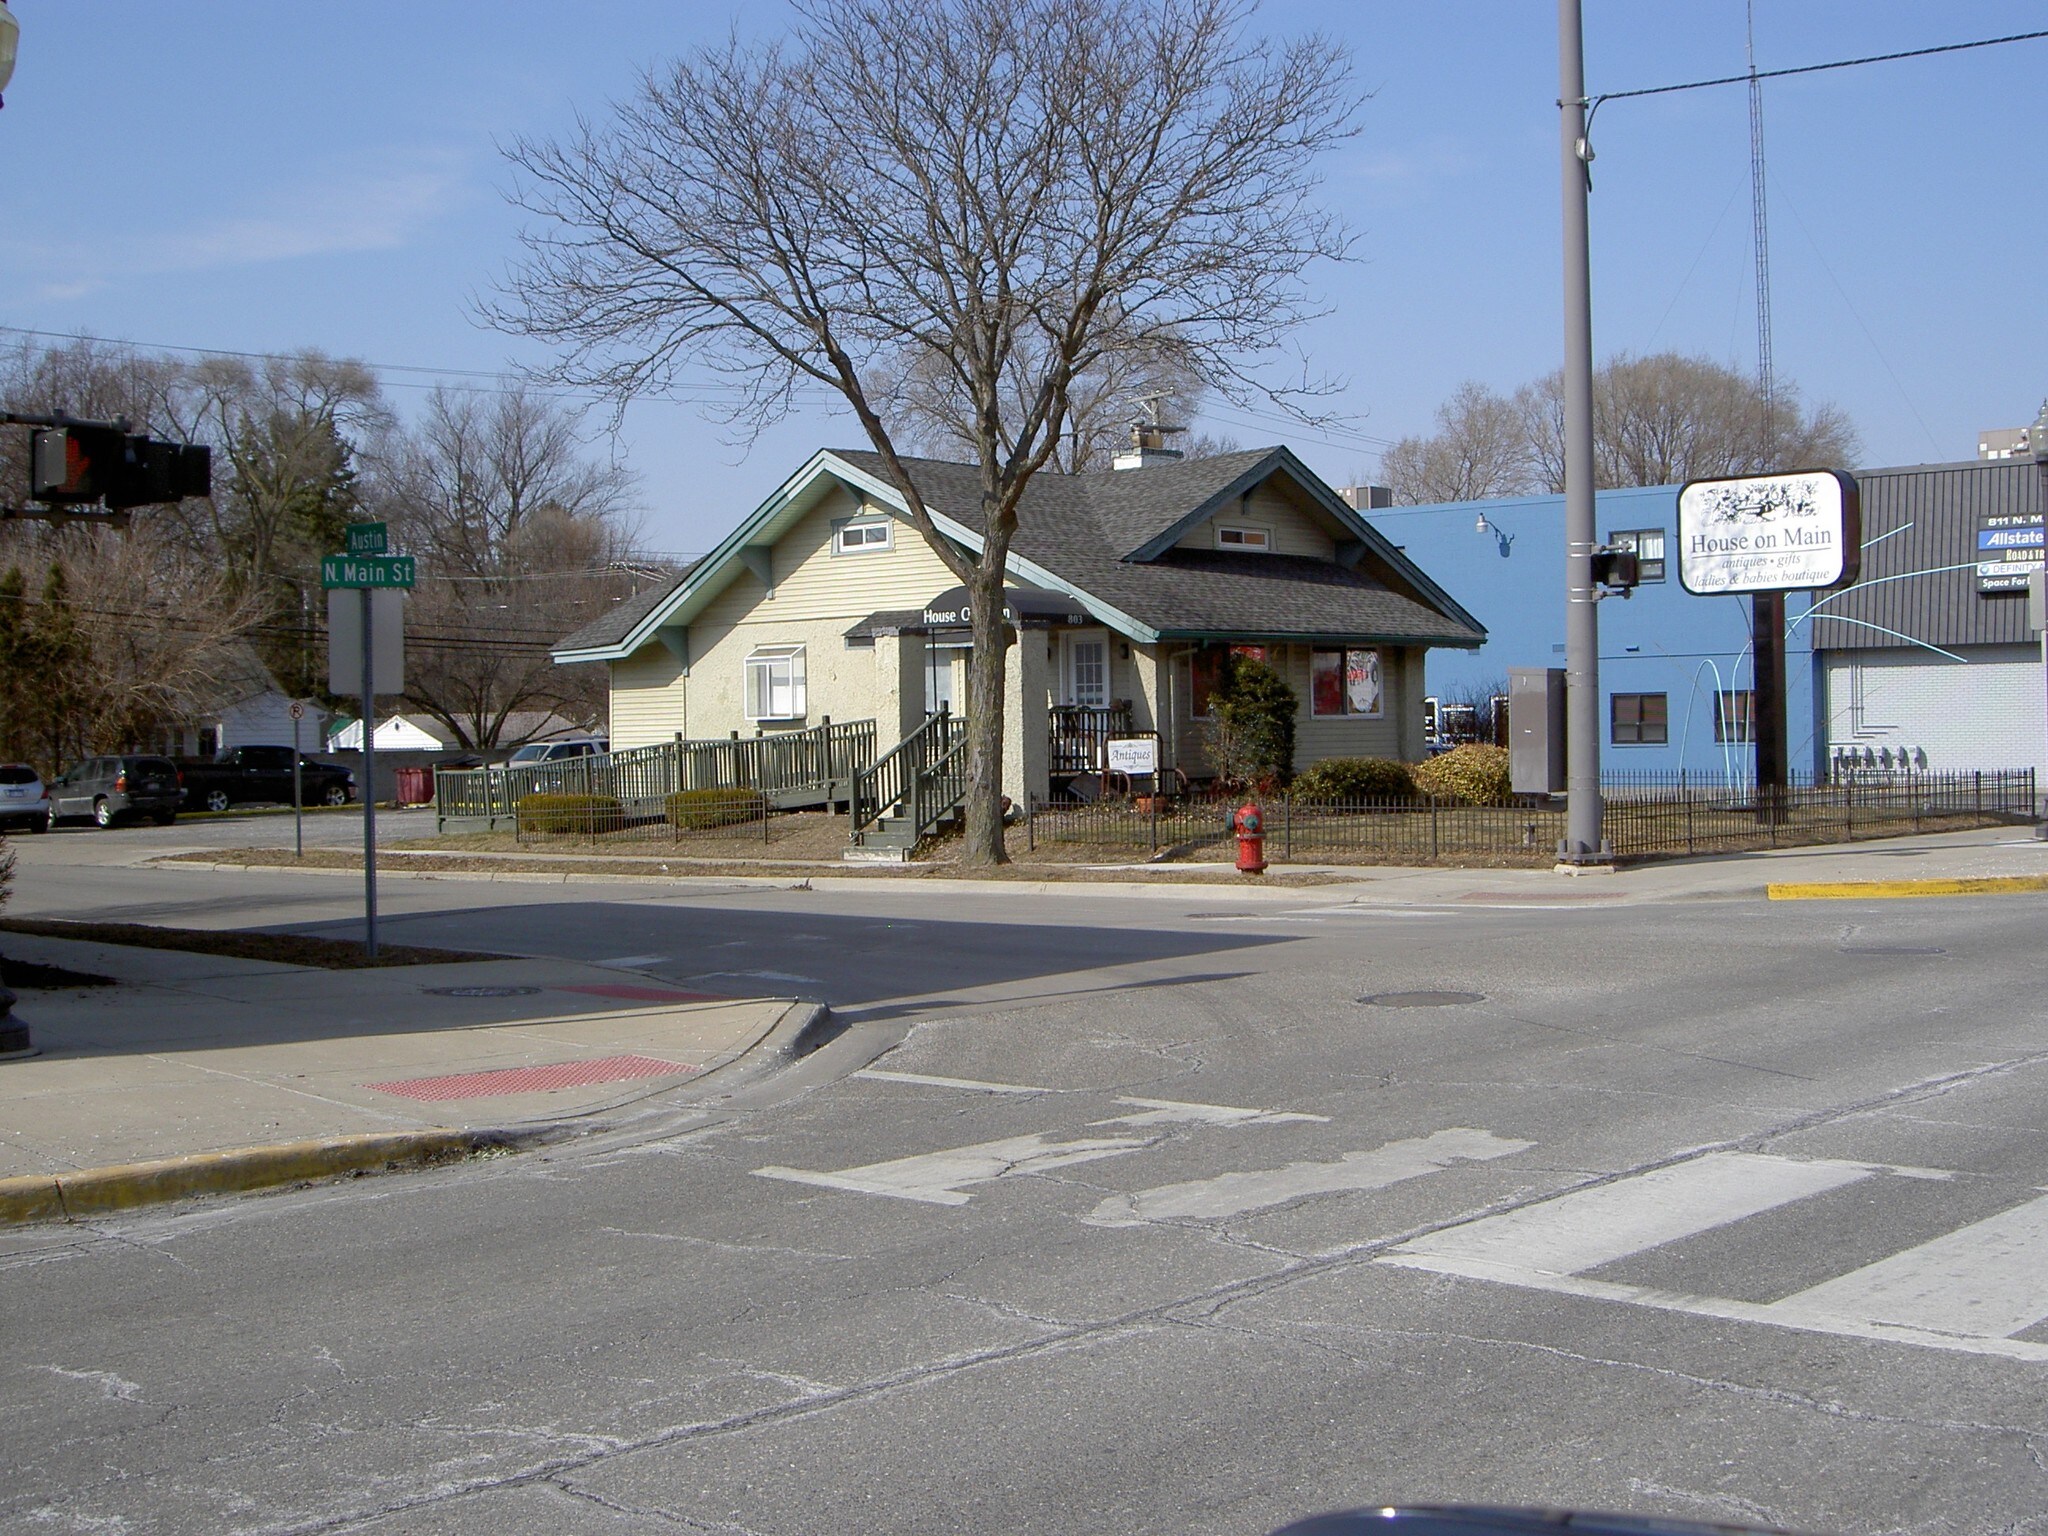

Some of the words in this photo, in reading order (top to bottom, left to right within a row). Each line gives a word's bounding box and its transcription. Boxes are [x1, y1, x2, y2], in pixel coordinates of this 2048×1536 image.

[1988, 517, 2009, 527] 811
[2012, 515, 2027, 525] N.
[351, 530, 383, 550] Austin
[1691, 533, 1749, 553] House
[1755, 533, 1777, 549] on
[1784, 525, 1832, 547] Main
[1986, 531, 2044, 546] Allstate
[1722, 555, 1767, 570] antiques
[1776, 552, 1801, 568] gifts
[325, 562, 339, 582] N.
[344, 562, 385, 582] Main
[392, 562, 411, 582] St
[1694, 575, 1726, 587] ladies
[1729, 573, 1739, 585] &
[1742, 571, 1778, 584] babies
[1781, 568, 1830, 582] boutique
[1982, 578, 2010, 589] Space
[2011, 576, 2027, 586] For
[923, 609, 956, 624] House
[1067, 614, 1083, 625] 803
[1111, 749, 1151, 764] Antiques
